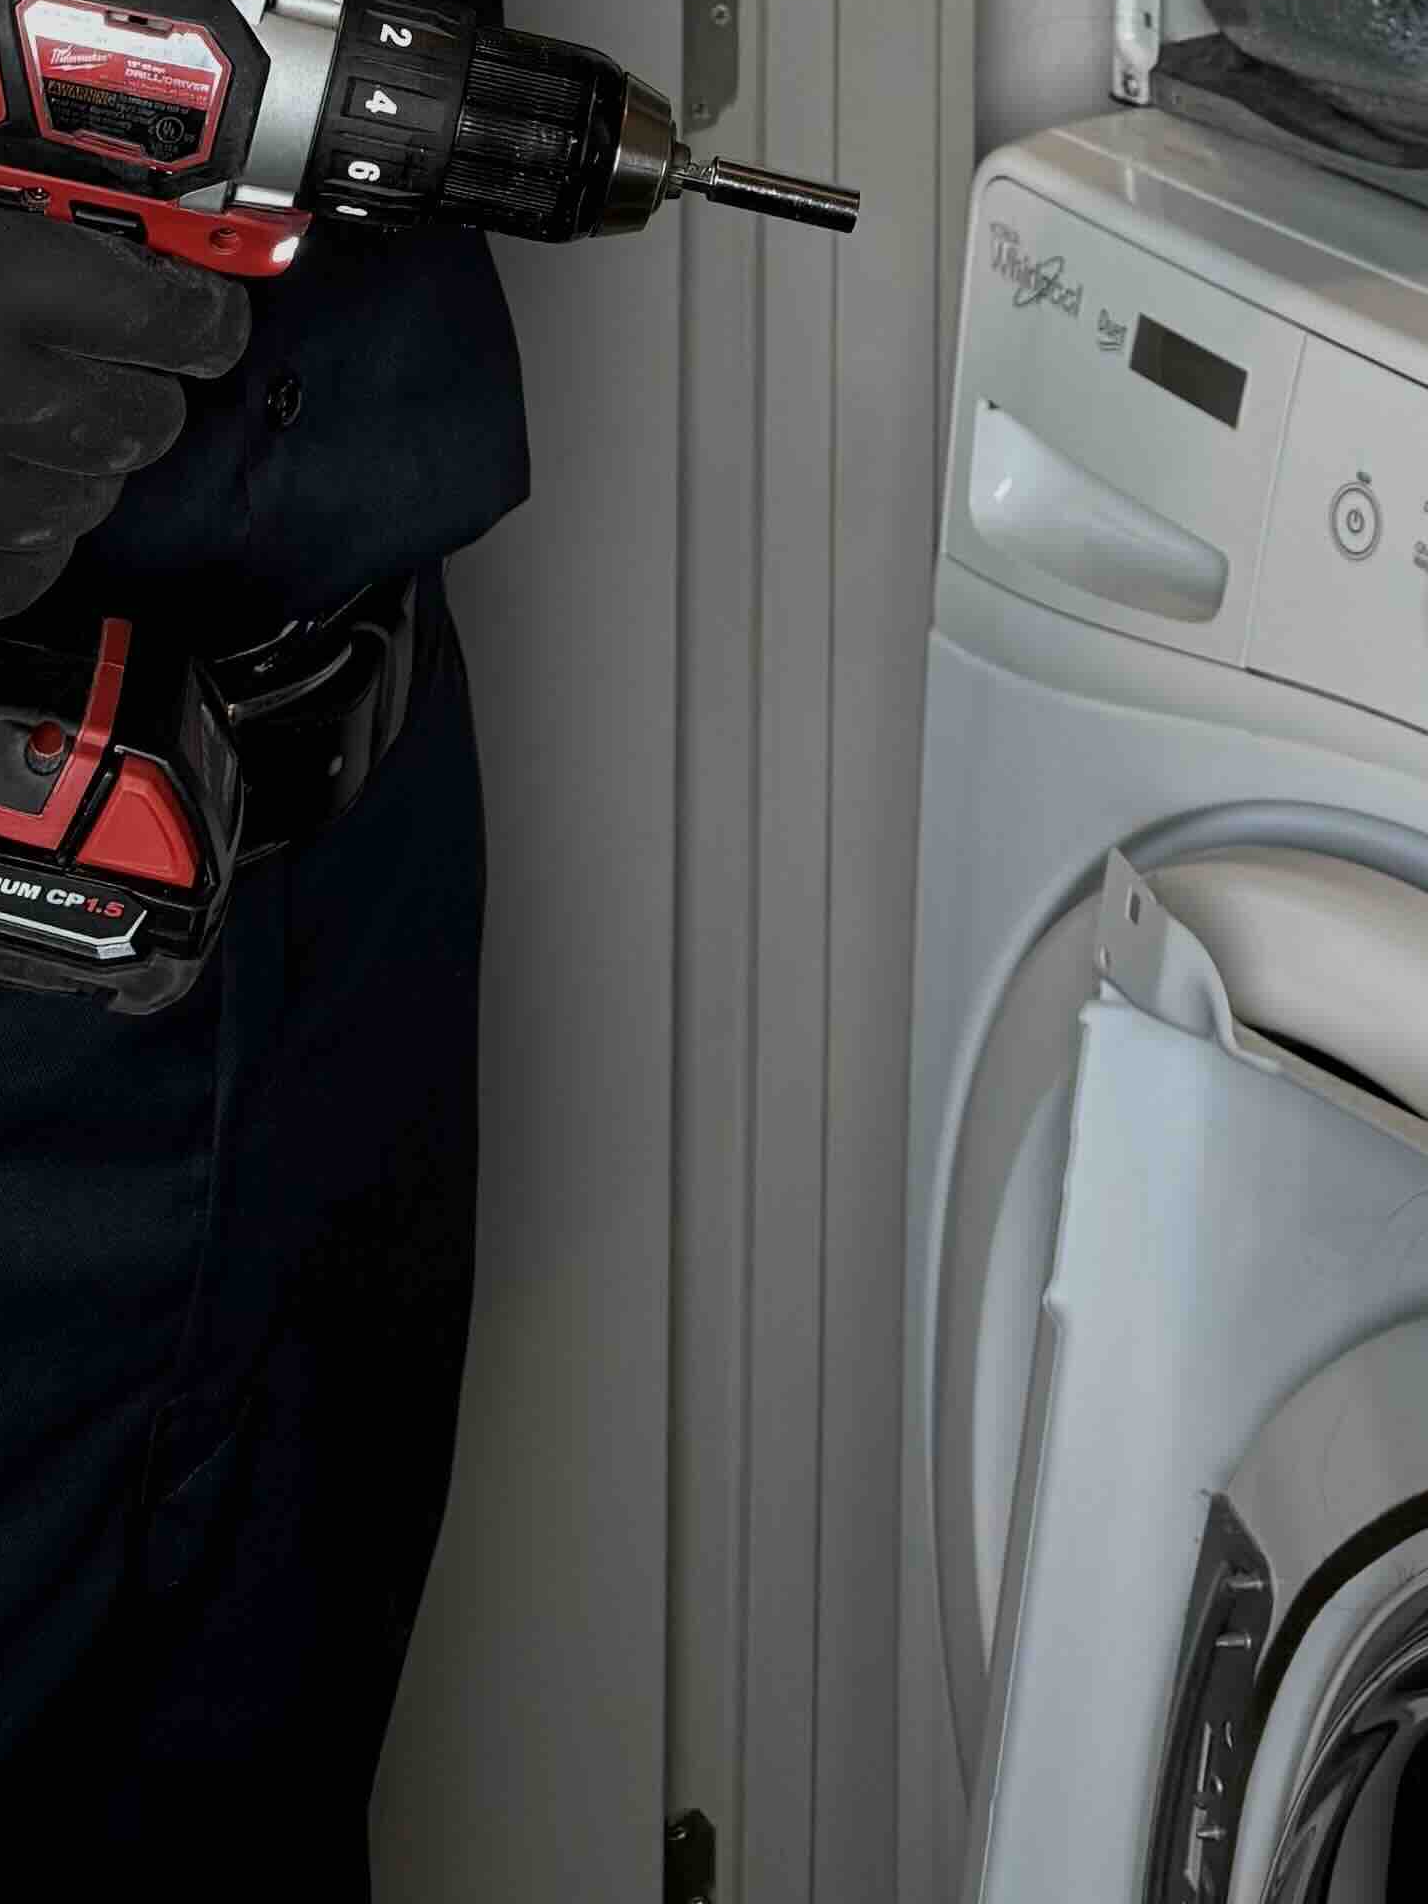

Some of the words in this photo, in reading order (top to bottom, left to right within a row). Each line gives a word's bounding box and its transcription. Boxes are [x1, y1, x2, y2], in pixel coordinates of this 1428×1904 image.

[380, 24, 412, 47] 2
[365, 90, 397, 115] 4
[348, 161, 380, 182] 6
